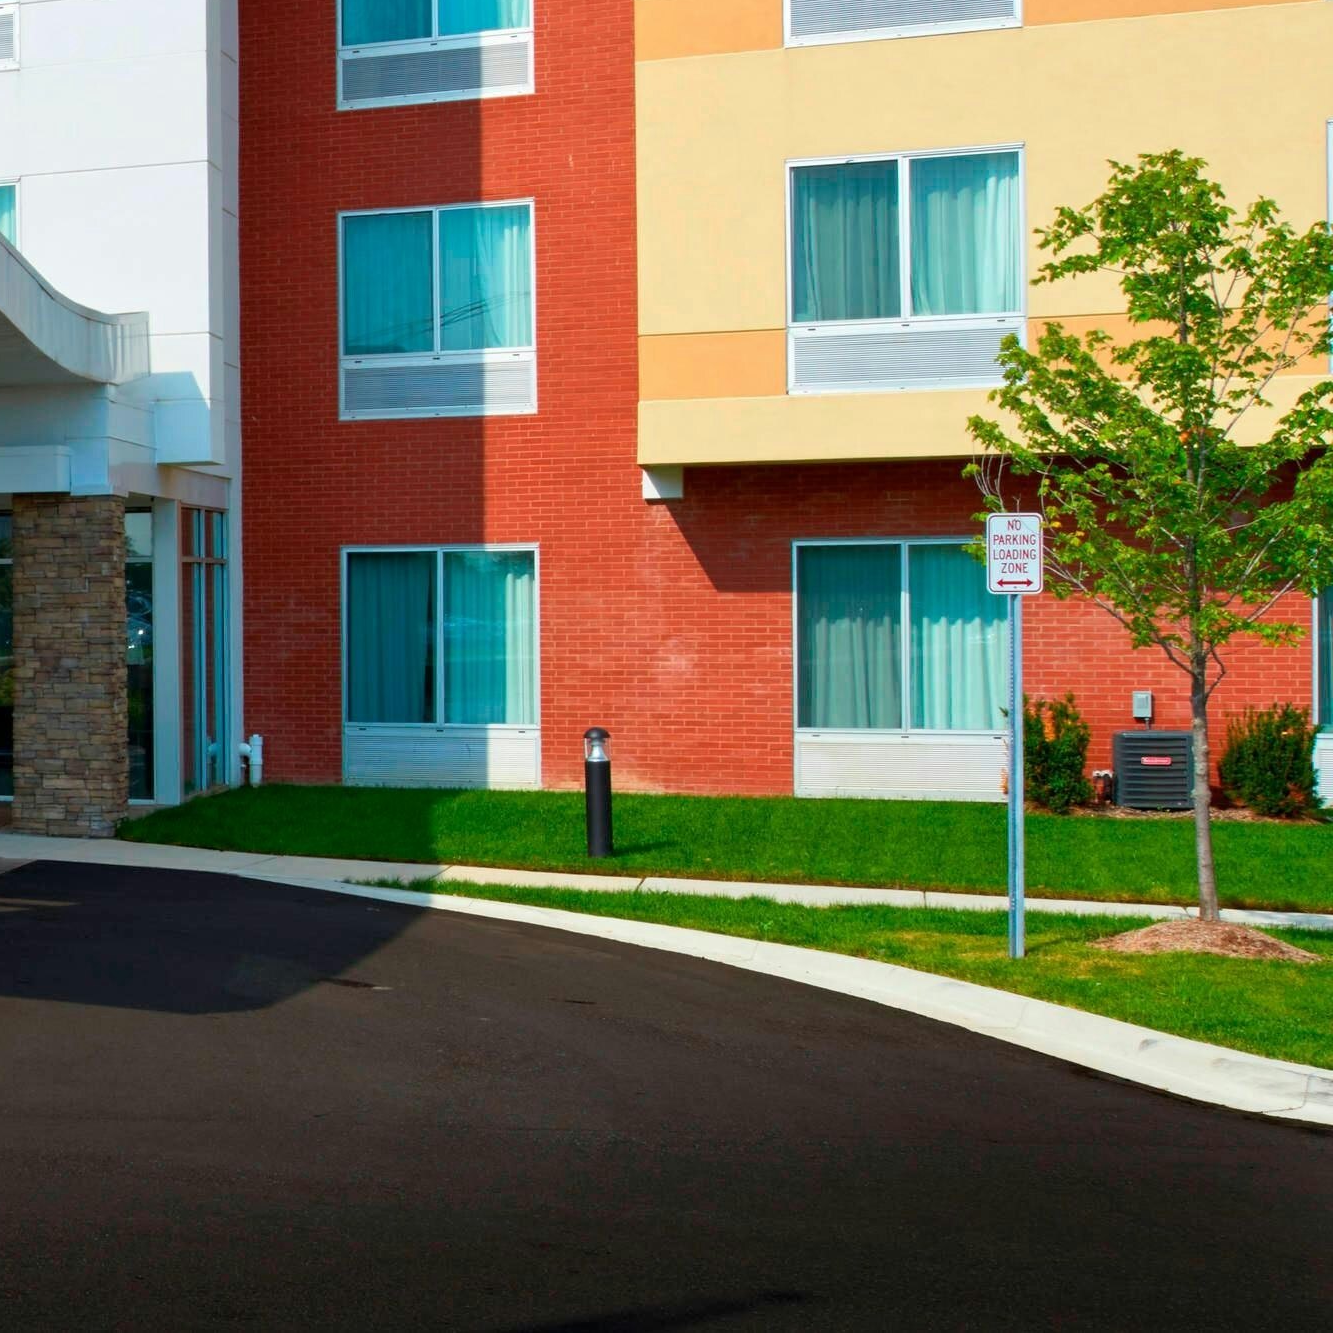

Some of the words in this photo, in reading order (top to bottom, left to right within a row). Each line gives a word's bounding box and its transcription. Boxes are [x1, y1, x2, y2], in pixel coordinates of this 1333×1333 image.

[1007, 520, 1021, 530] NO
[993, 534, 1037, 545] PARKING
[993, 549, 1037, 560] LOADING
[1001, 563, 1028, 573] ZONE
